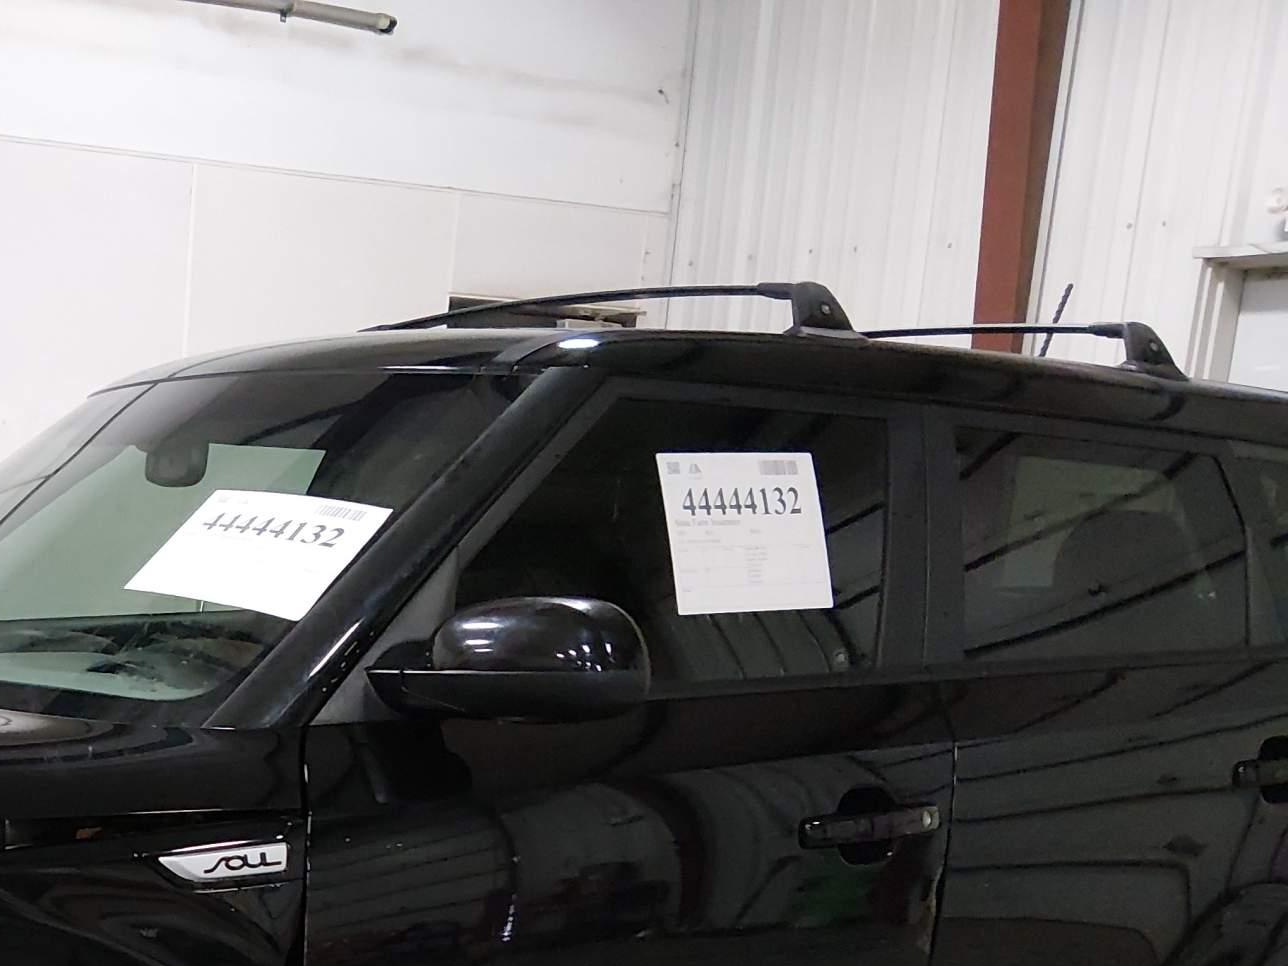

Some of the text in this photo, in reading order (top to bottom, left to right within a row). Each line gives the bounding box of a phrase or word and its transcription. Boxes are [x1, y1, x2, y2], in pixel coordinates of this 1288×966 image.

[682, 486, 802, 516] 44444132
[203, 512, 345, 548] 44444132
[203, 852, 282, 874] SOUL
